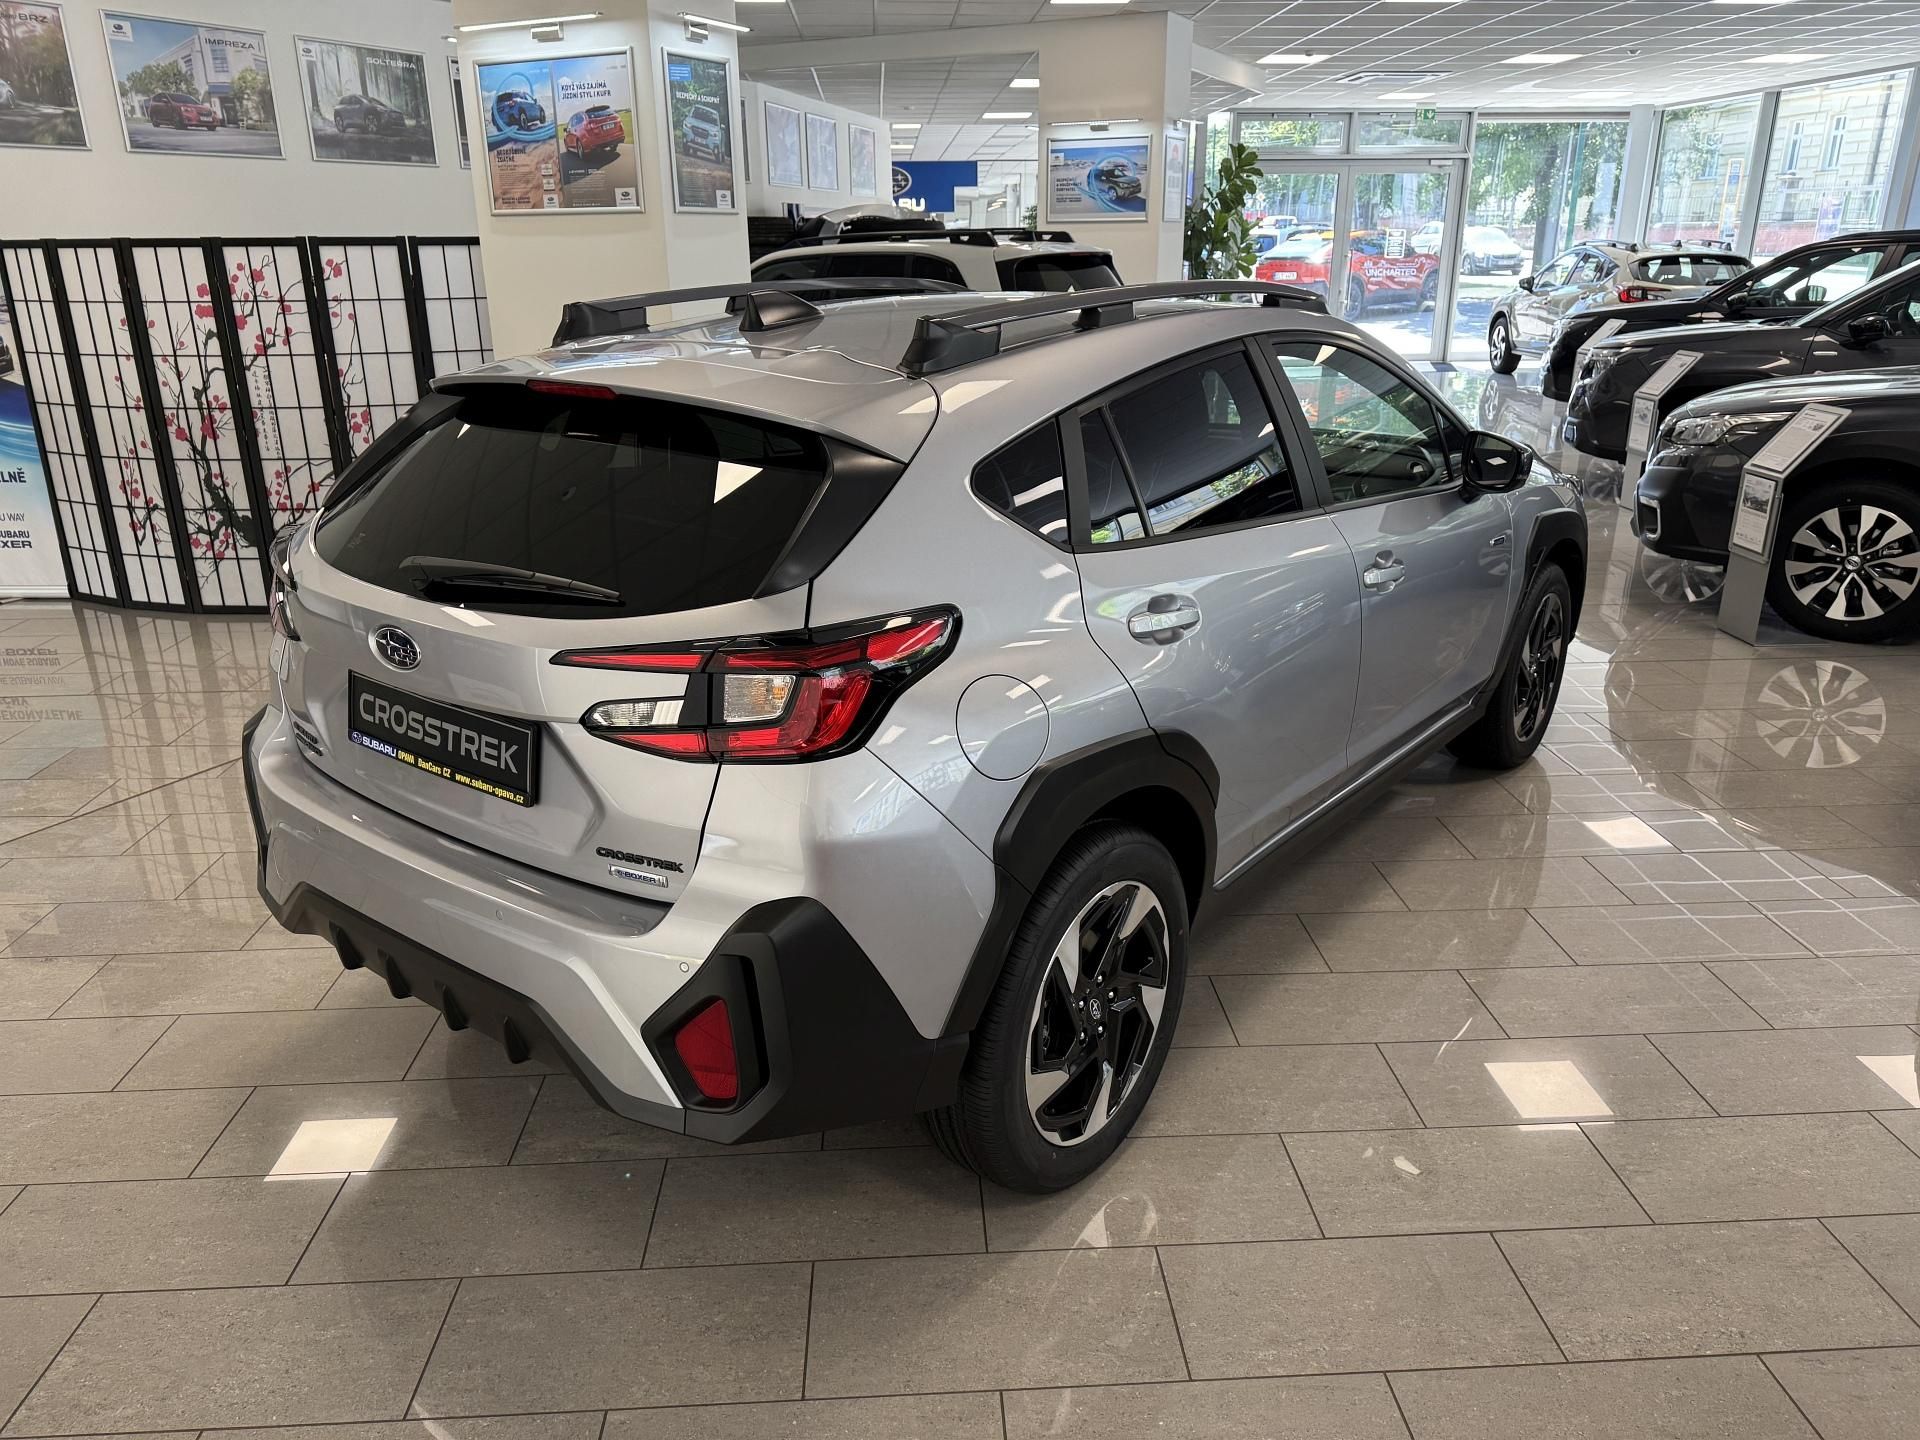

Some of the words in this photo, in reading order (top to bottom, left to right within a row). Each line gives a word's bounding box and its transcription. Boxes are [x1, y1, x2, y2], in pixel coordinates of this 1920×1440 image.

[18, 12, 49, 24] BRZ
[204, 37, 256, 50] IMPREZA
[365, 56, 417, 70] SOLTERRA
[1365, 268, 1417, 277] UNCHARTED
[6, 512, 25, 521] WAY
[359, 692, 519, 774] CROSSTREK
[362, 736, 397, 757] SUBARU
[397, 750, 415, 764] OPAVA
[417, 757, 442, 775] DanCars
[442, 767, 451, 778] CZ
[455, 772, 524, 804] www.subaru-opava.cz
[595, 846, 685, 874] CROSSTREK
